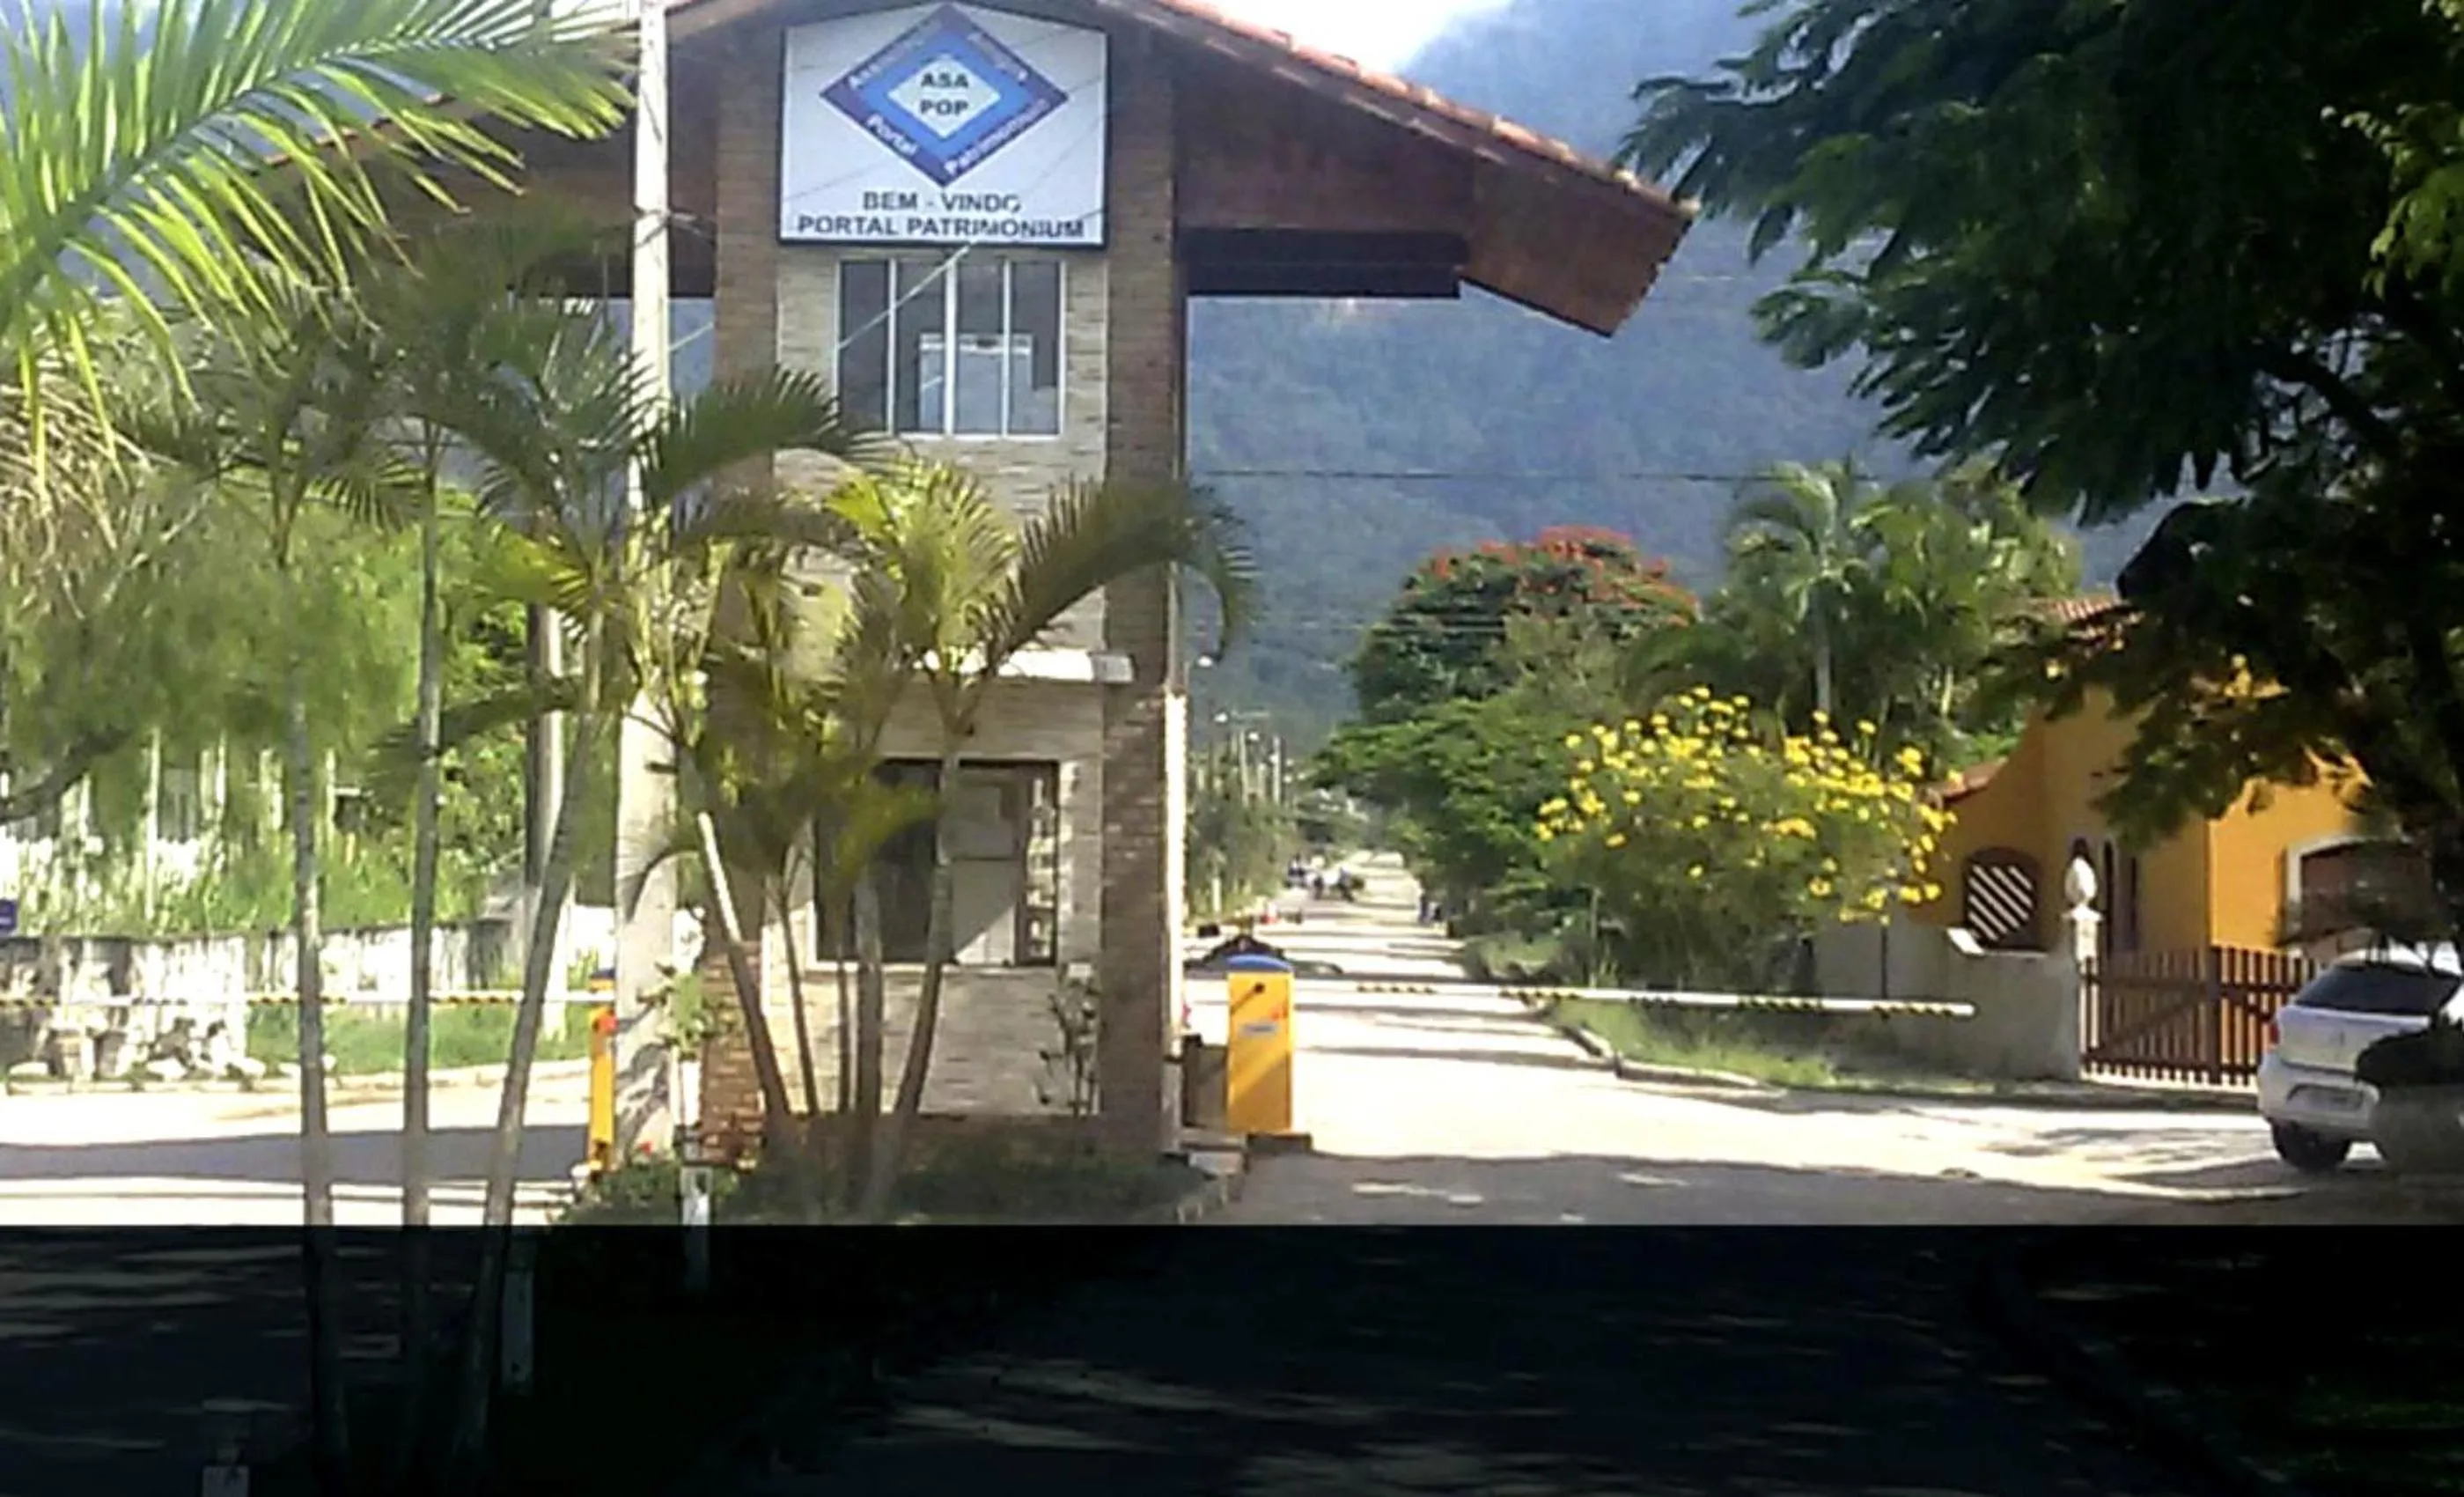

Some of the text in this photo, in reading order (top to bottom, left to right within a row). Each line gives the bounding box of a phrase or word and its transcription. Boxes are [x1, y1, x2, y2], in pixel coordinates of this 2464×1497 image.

[920, 72, 968, 88] ASA
[920, 99, 968, 116] POP
[866, 114, 918, 156] Portal
[862, 190, 918, 210] BEM
[940, 192, 1021, 212] VINDO
[797, 215, 1085, 238] PORTAL PATRIMONIUM
